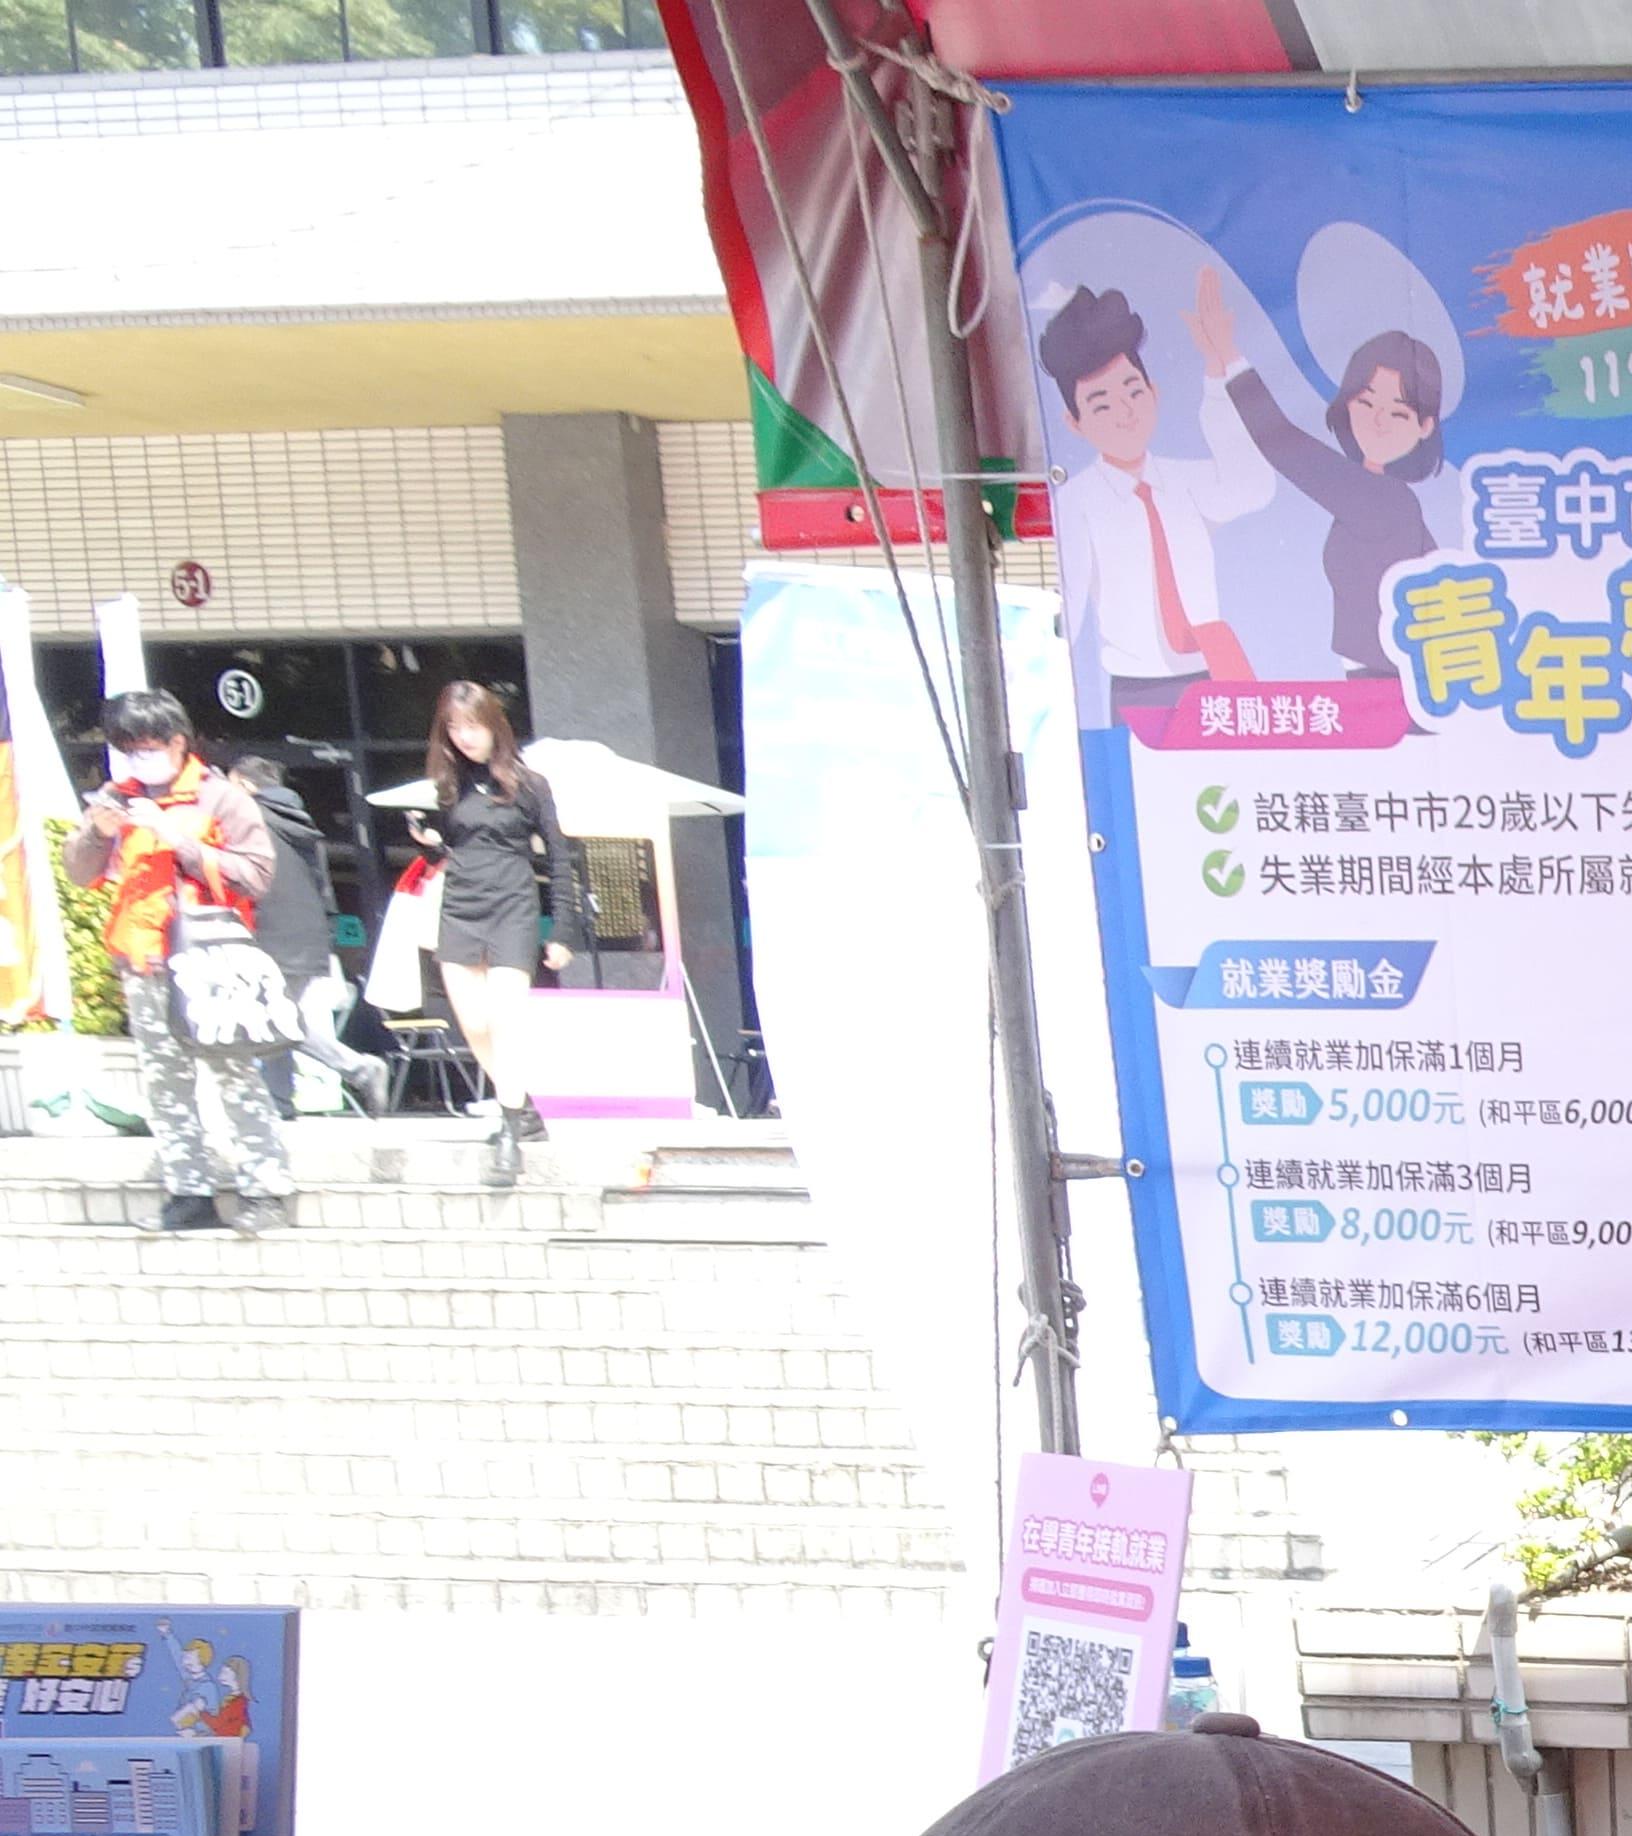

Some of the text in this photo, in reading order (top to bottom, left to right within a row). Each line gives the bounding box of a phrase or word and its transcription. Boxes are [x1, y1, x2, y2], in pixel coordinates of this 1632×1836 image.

[1200, 694, 1344, 737] 獎勵對象
[1220, 958, 1404, 1000] 就業獎勵金
[1234, 1040, 1524, 1074] 連續就業加保滿1個月
[1249, 1087, 1308, 1121] 獎勵
[1328, 1087, 1466, 1128] 5,000元
[1245, 1159, 1532, 1195] 連續就業加保滿3個月
[1261, 1206, 1320, 1239] 獎勵
[1341, 1206, 1474, 1247] 8,000元
[1259, 1276, 1542, 1313] 連續就業加保滿6個月
[1276, 1318, 1332, 1350] 獎勵
[1350, 1319, 1509, 1358] 12,000元
